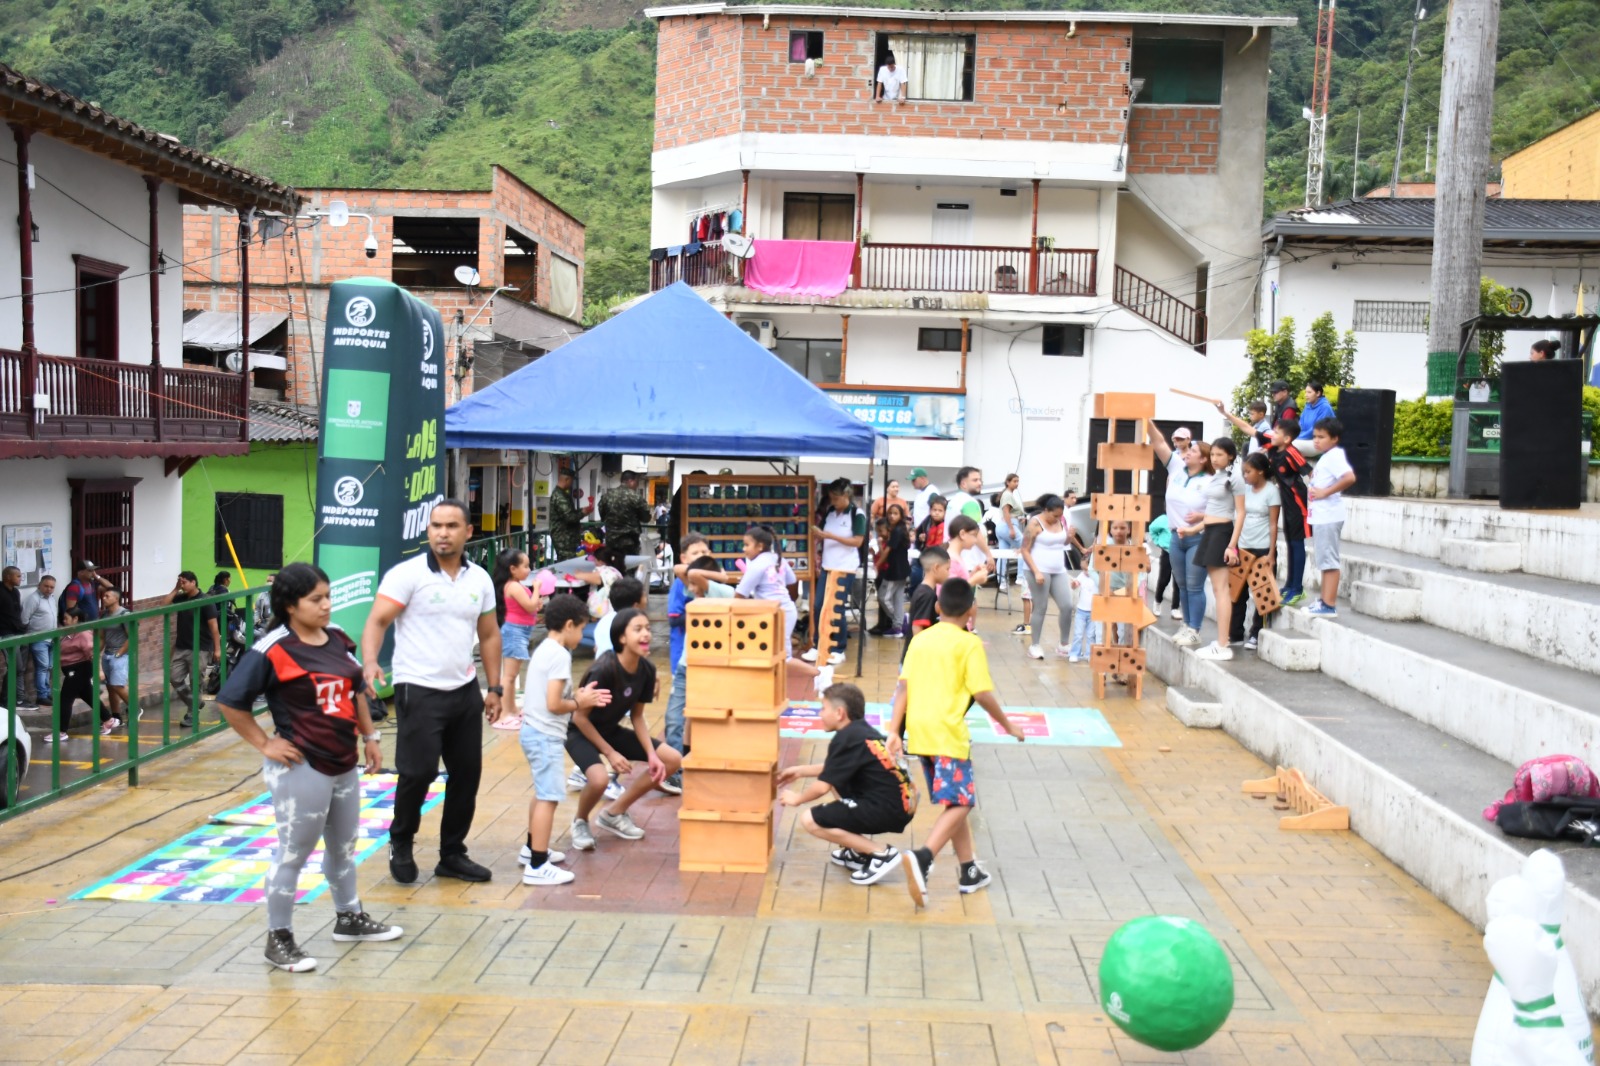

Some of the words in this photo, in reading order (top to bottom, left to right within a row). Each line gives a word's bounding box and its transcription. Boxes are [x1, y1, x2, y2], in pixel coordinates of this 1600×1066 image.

[333, 327, 390, 339] INDEPORTES
[334, 338, 386, 349] ANTIOQUIA
[877, 396, 904, 406] GRATIS
[854, 409, 876, 422] 993
[878, 410, 895, 423] 63
[895, 410, 912, 424] 68
[322, 506, 379, 517] INDEPORTES
[323, 516, 375, 527] ANTIOQUIA
